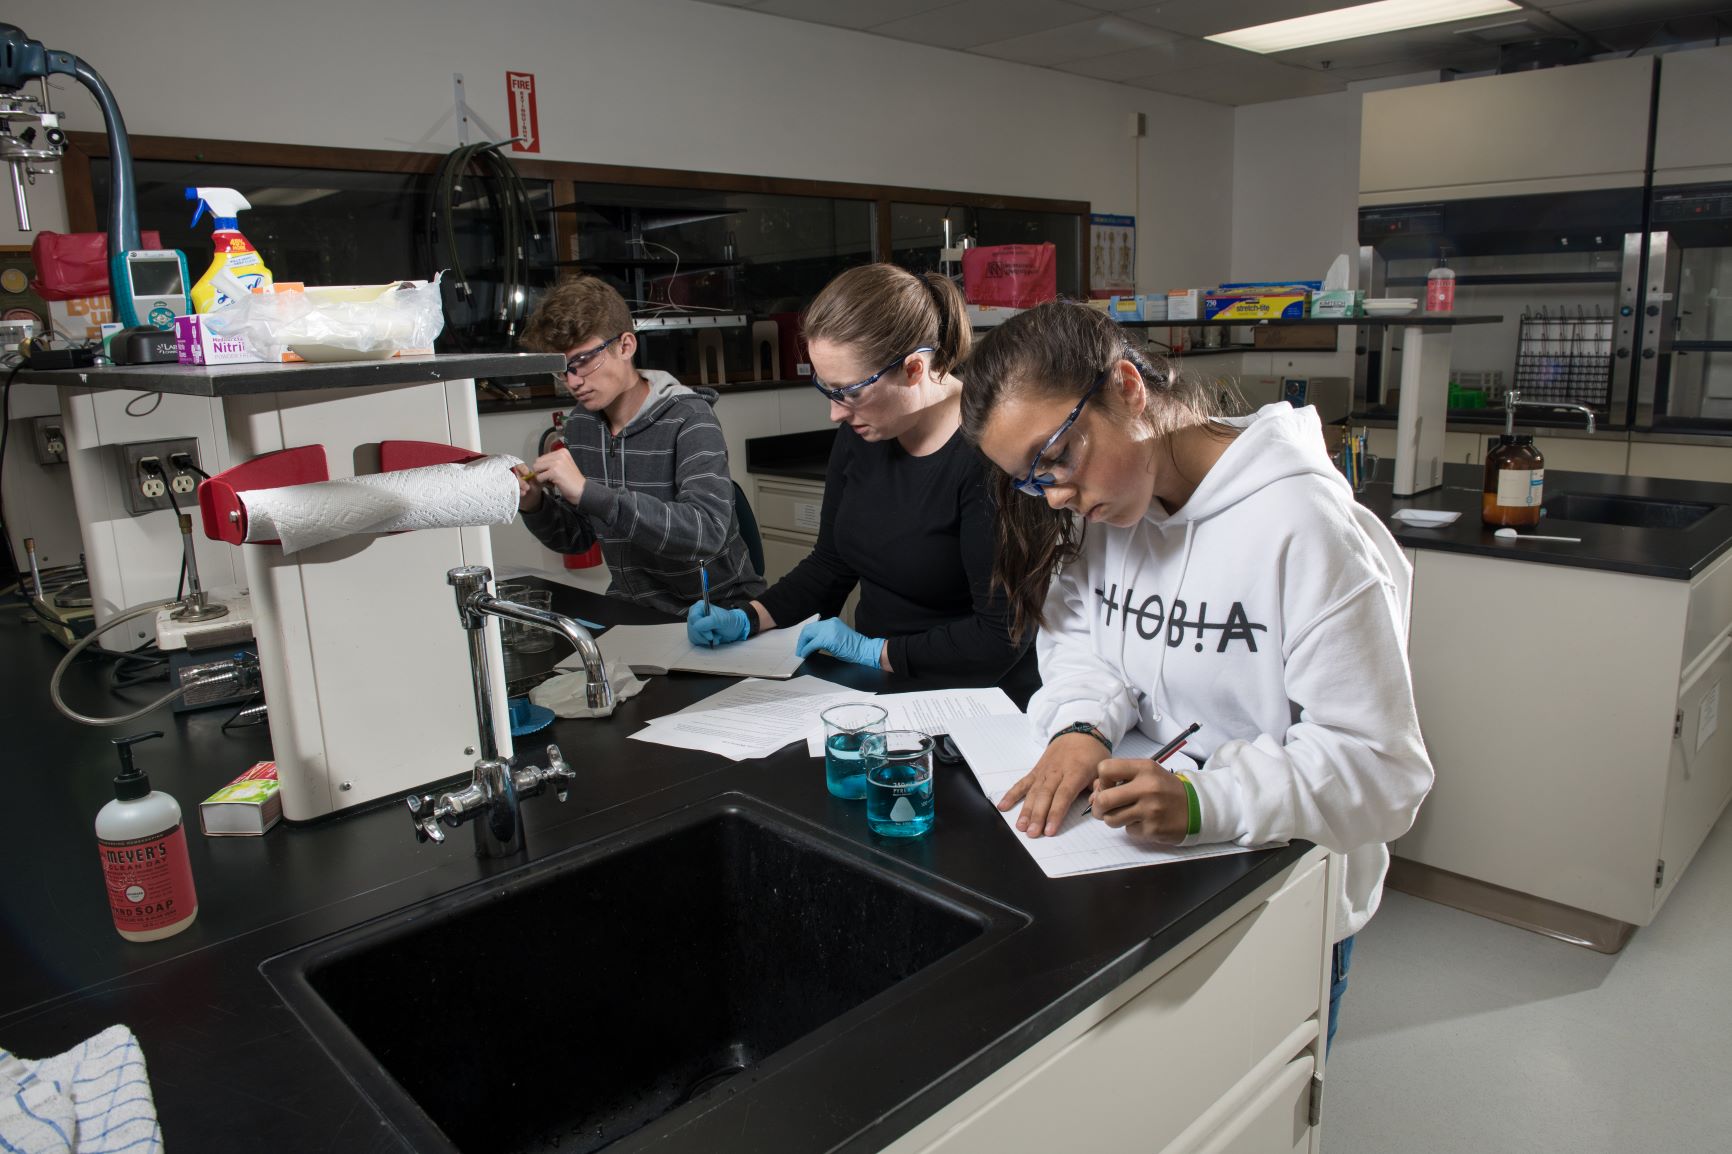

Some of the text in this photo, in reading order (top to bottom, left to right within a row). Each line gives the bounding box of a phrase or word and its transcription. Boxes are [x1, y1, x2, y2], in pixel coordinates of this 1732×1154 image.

[512, 79, 530, 90] FIRE
[106, 843, 166, 864] MEYER'S
[146, 857, 167, 868] DAY
[135, 899, 173, 916] SOAP
